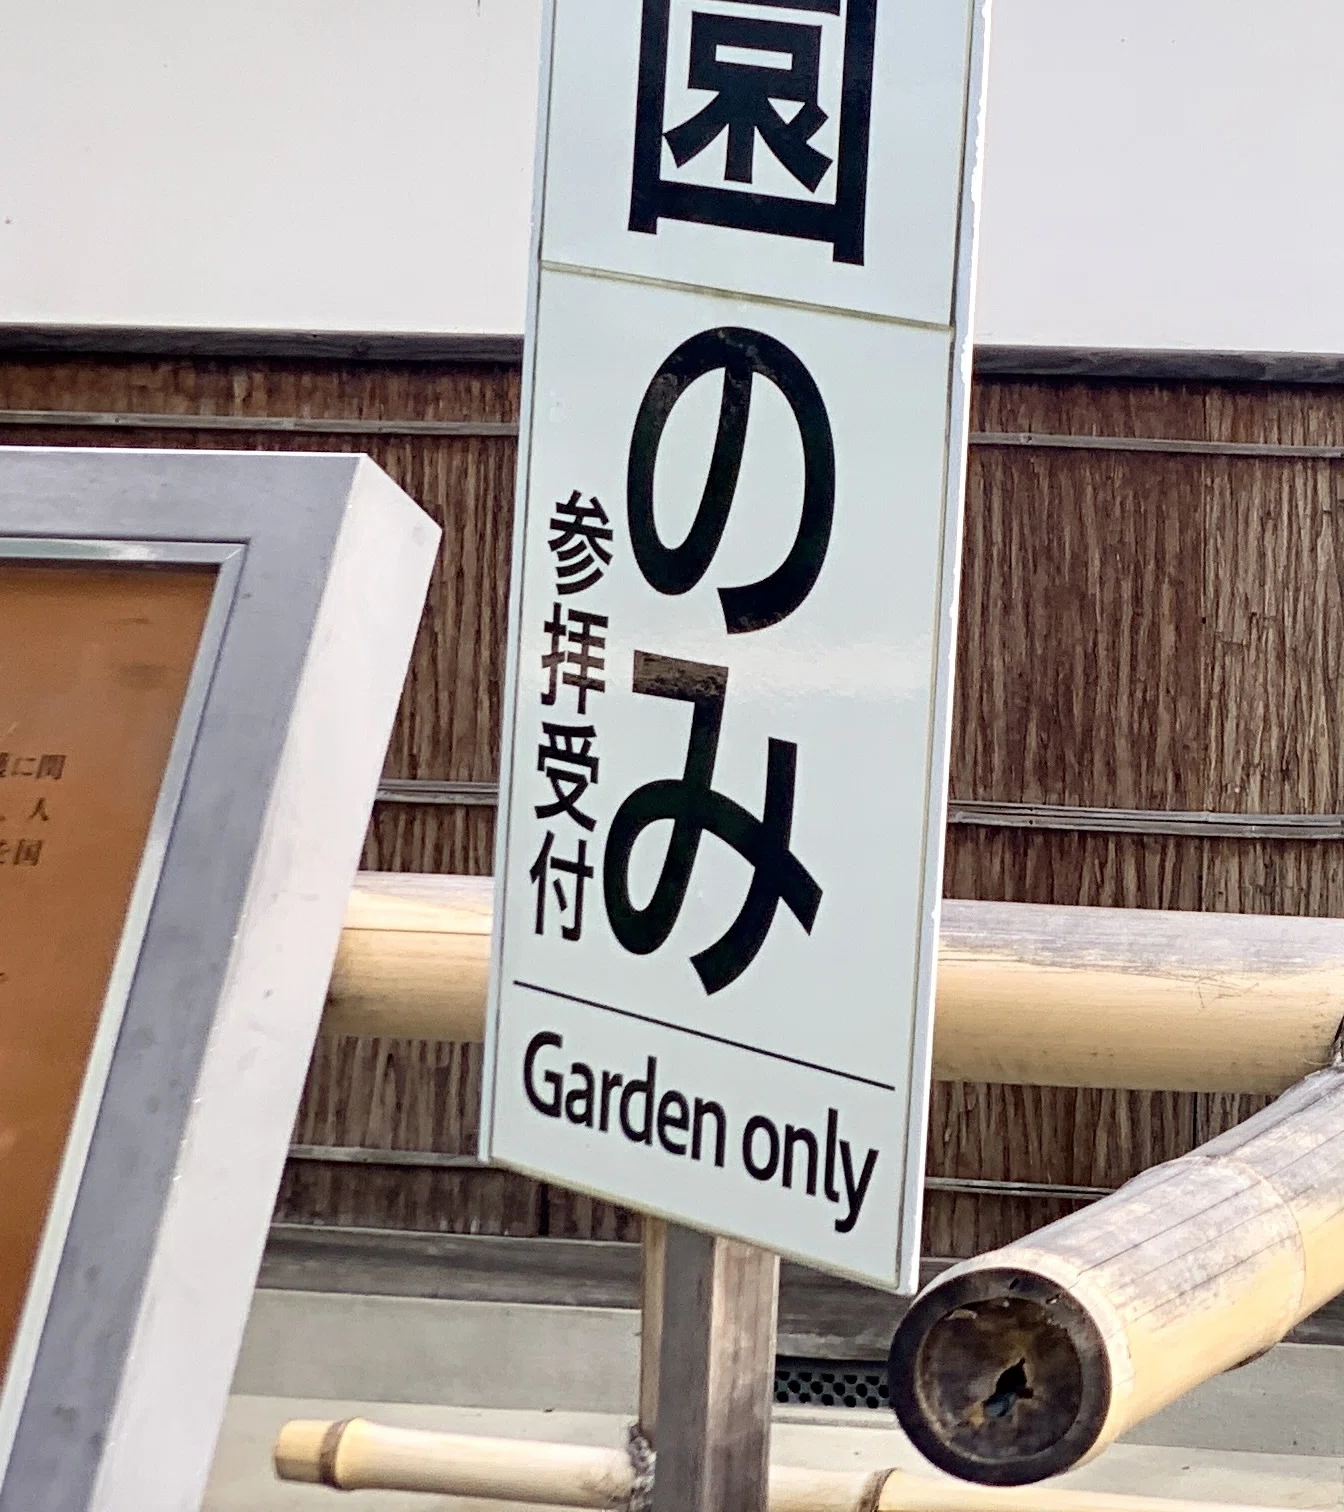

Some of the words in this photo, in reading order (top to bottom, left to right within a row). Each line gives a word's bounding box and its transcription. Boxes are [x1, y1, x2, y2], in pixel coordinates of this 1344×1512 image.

[528, 489, 614, 941] 参拝受付
[523, 1031, 727, 1167] Garden
[742, 1108, 879, 1235] only
